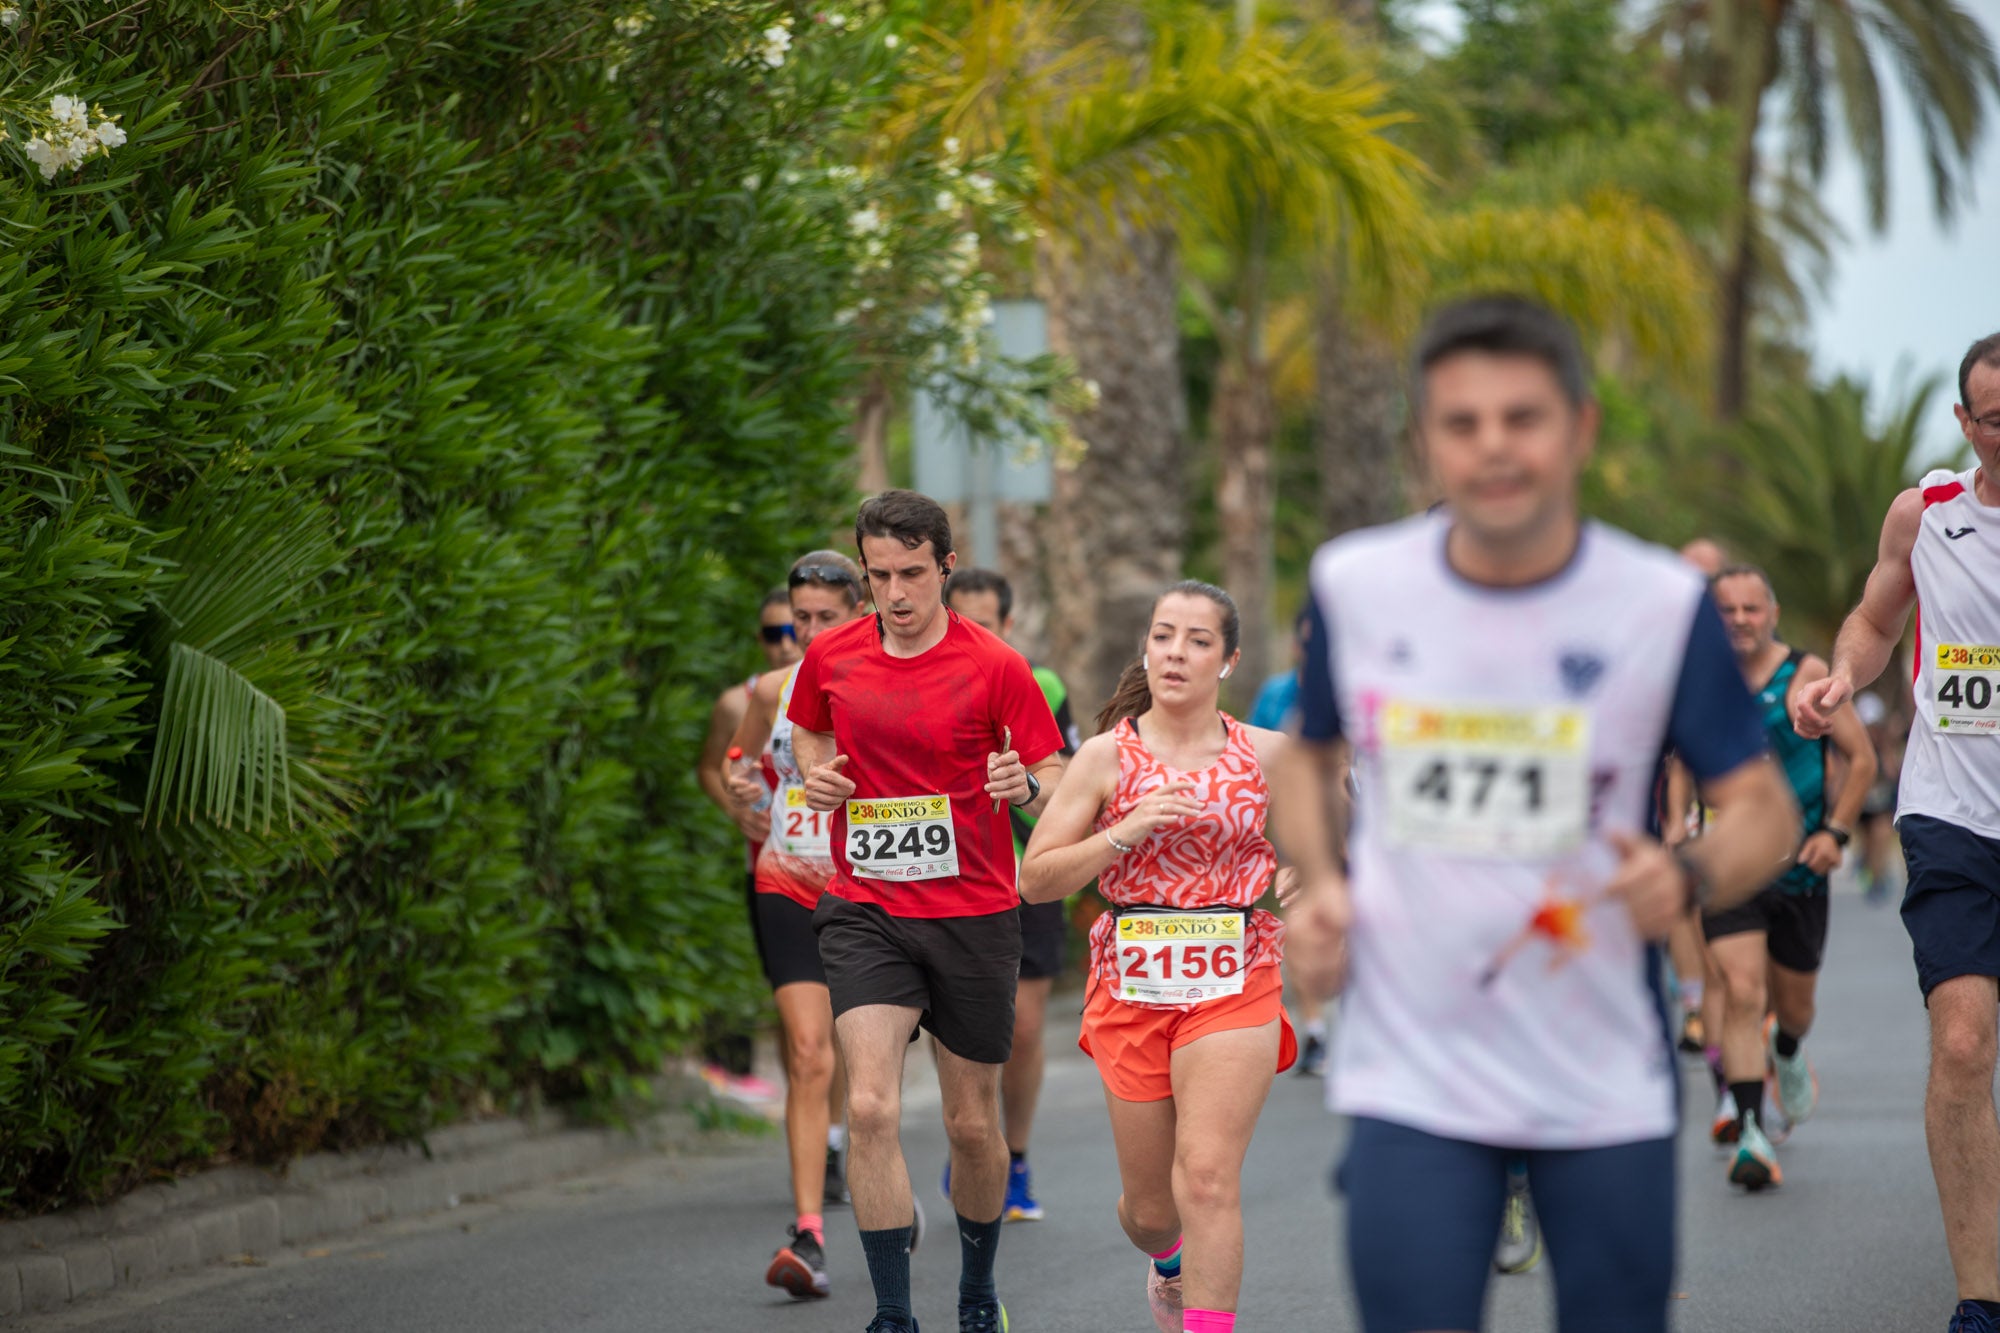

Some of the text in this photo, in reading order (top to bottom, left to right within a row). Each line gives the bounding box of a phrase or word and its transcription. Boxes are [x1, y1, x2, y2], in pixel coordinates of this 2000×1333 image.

[1951, 648, 1968, 664] 38
[1938, 675, 2000, 710] 40
[1412, 759, 1543, 814] 471
[861, 804, 874, 819] 38
[874, 806, 927, 819] FONDO
[850, 824, 950, 861] 3249
[1135, 920, 1154, 935] 38
[1155, 923, 1217, 935] FONDO
[1122, 944, 1238, 979] 2156
